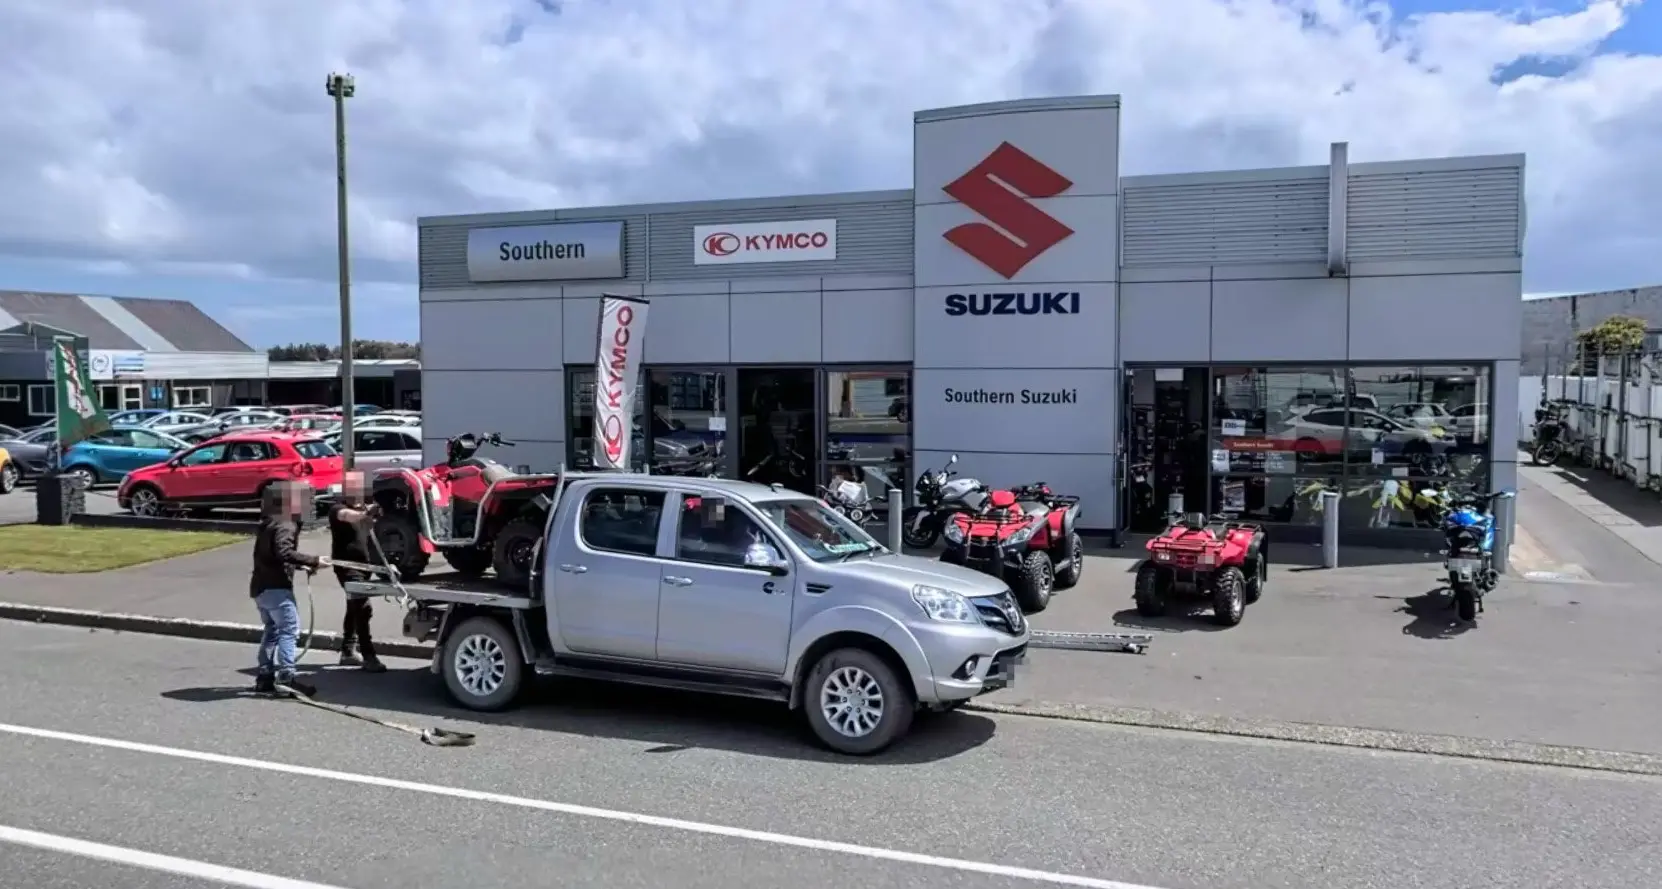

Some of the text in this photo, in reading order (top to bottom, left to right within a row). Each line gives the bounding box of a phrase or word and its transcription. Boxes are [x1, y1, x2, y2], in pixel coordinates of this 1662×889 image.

[499, 240, 586, 262] Southern
[745, 232, 828, 251] KYMCO
[945, 292, 1081, 316] SUZUKI
[608, 305, 634, 408] KYMCO
[944, 387, 1077, 404] Southern Suzuki
